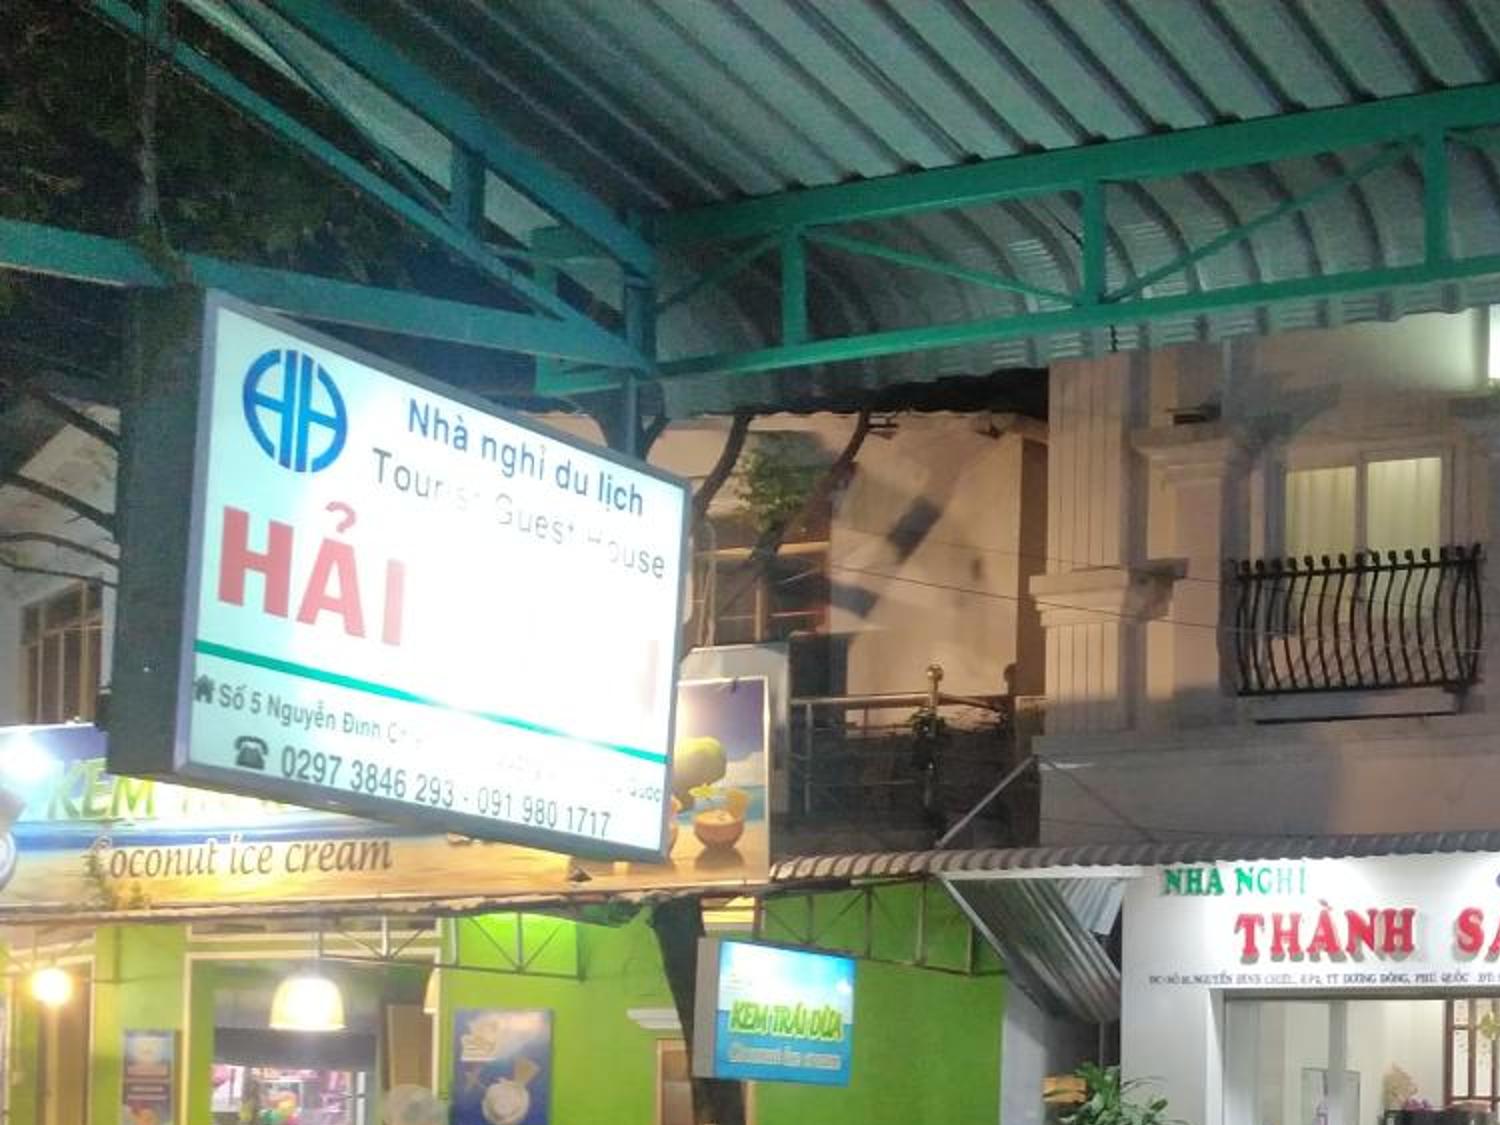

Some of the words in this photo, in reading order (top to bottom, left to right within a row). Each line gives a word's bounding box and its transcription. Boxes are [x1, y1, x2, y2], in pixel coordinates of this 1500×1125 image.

[408, 399, 469, 452] Nhà
[555, 460, 589, 497] du
[598, 472, 644, 516] lịch
[217, 501, 406, 646] HẢI
[219, 683, 247, 710] Số
[250, 691, 262, 714] 5
[281, 745, 342, 785] 0297
[350, 759, 407, 798] 3846
[415, 773, 454, 808] 293
[477, 786, 511, 816] 091
[522, 795, 558, 829] 980
[566, 806, 612, 837] 1717
[230, 833, 274, 875] ice
[284, 837, 394, 874] cream
[1234, 899, 1416, 961] THÀNH
